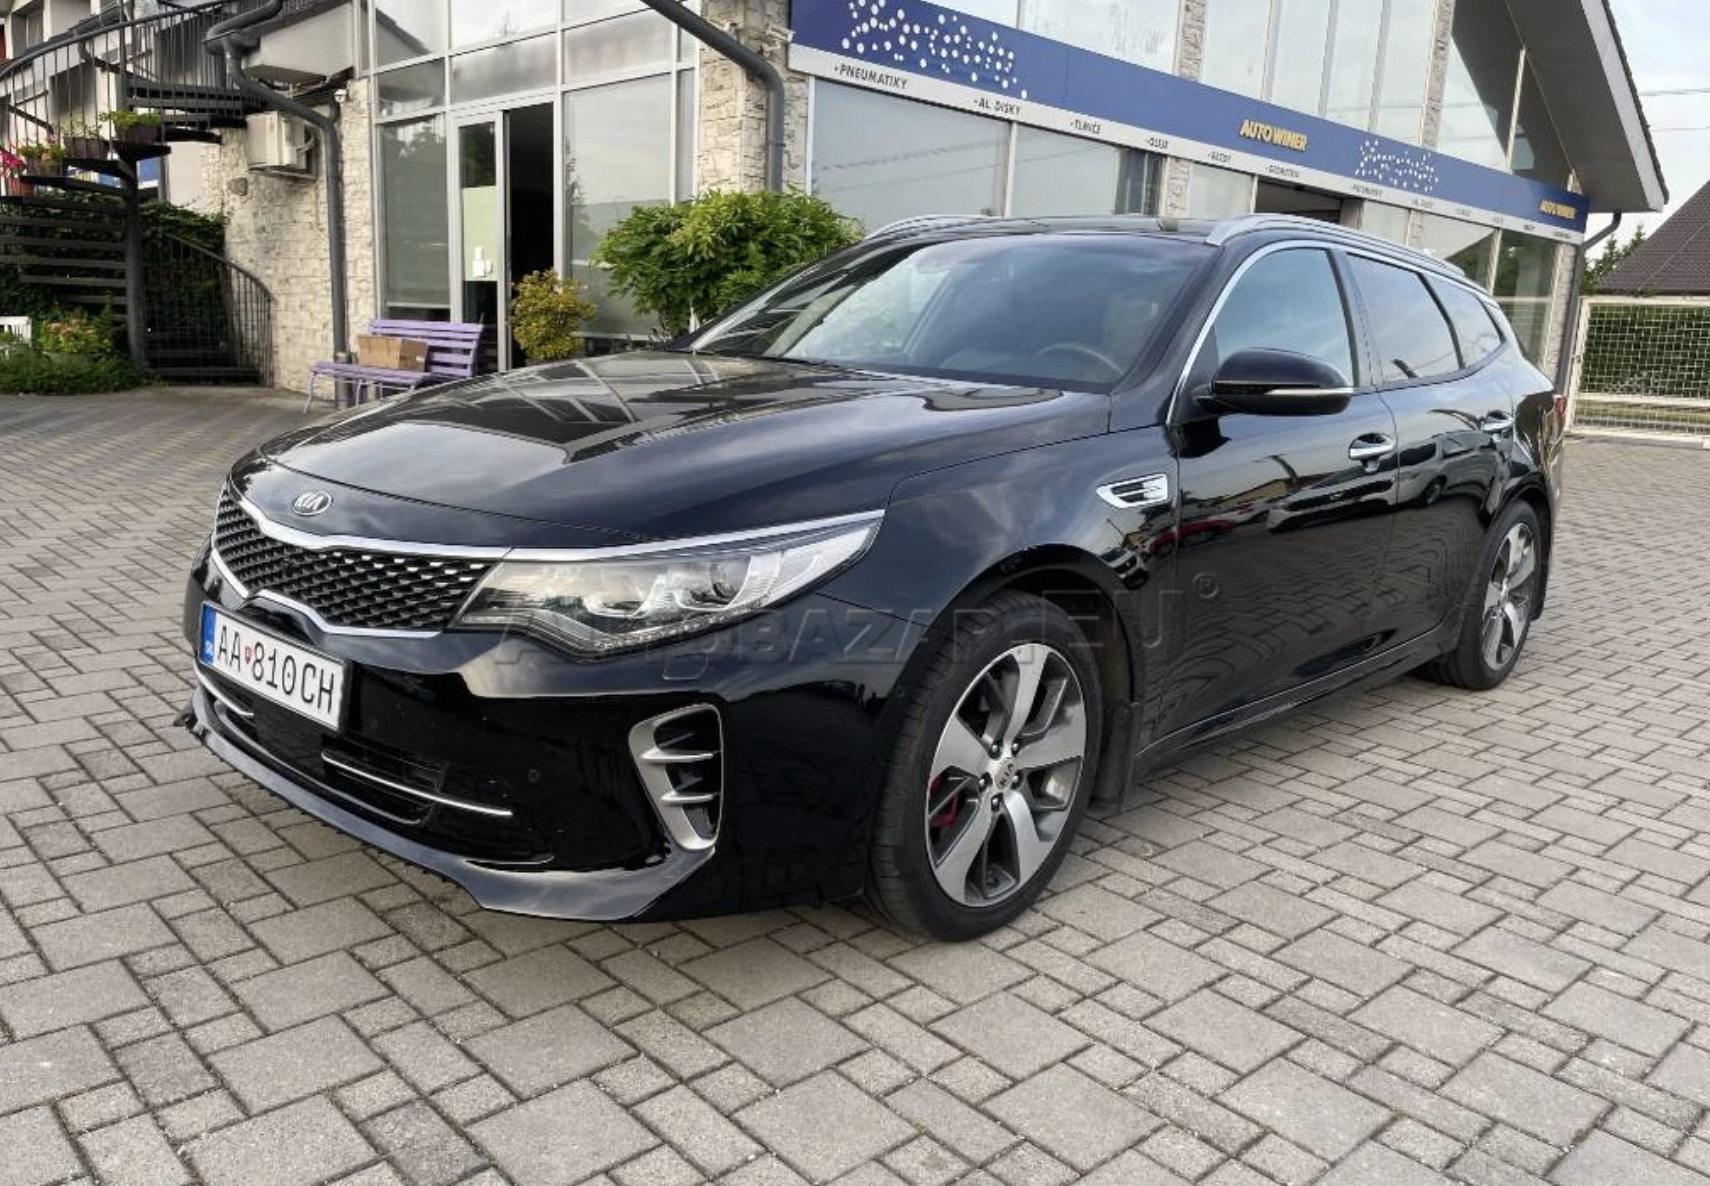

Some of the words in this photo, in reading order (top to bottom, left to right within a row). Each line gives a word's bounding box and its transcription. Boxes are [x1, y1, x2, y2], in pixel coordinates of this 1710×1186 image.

[839, 63, 908, 89] PNEUMATIKY
[1240, 119, 1273, 142] AUTO
[217, 625, 241, 672] AA
[252, 641, 334, 714] 810CH
